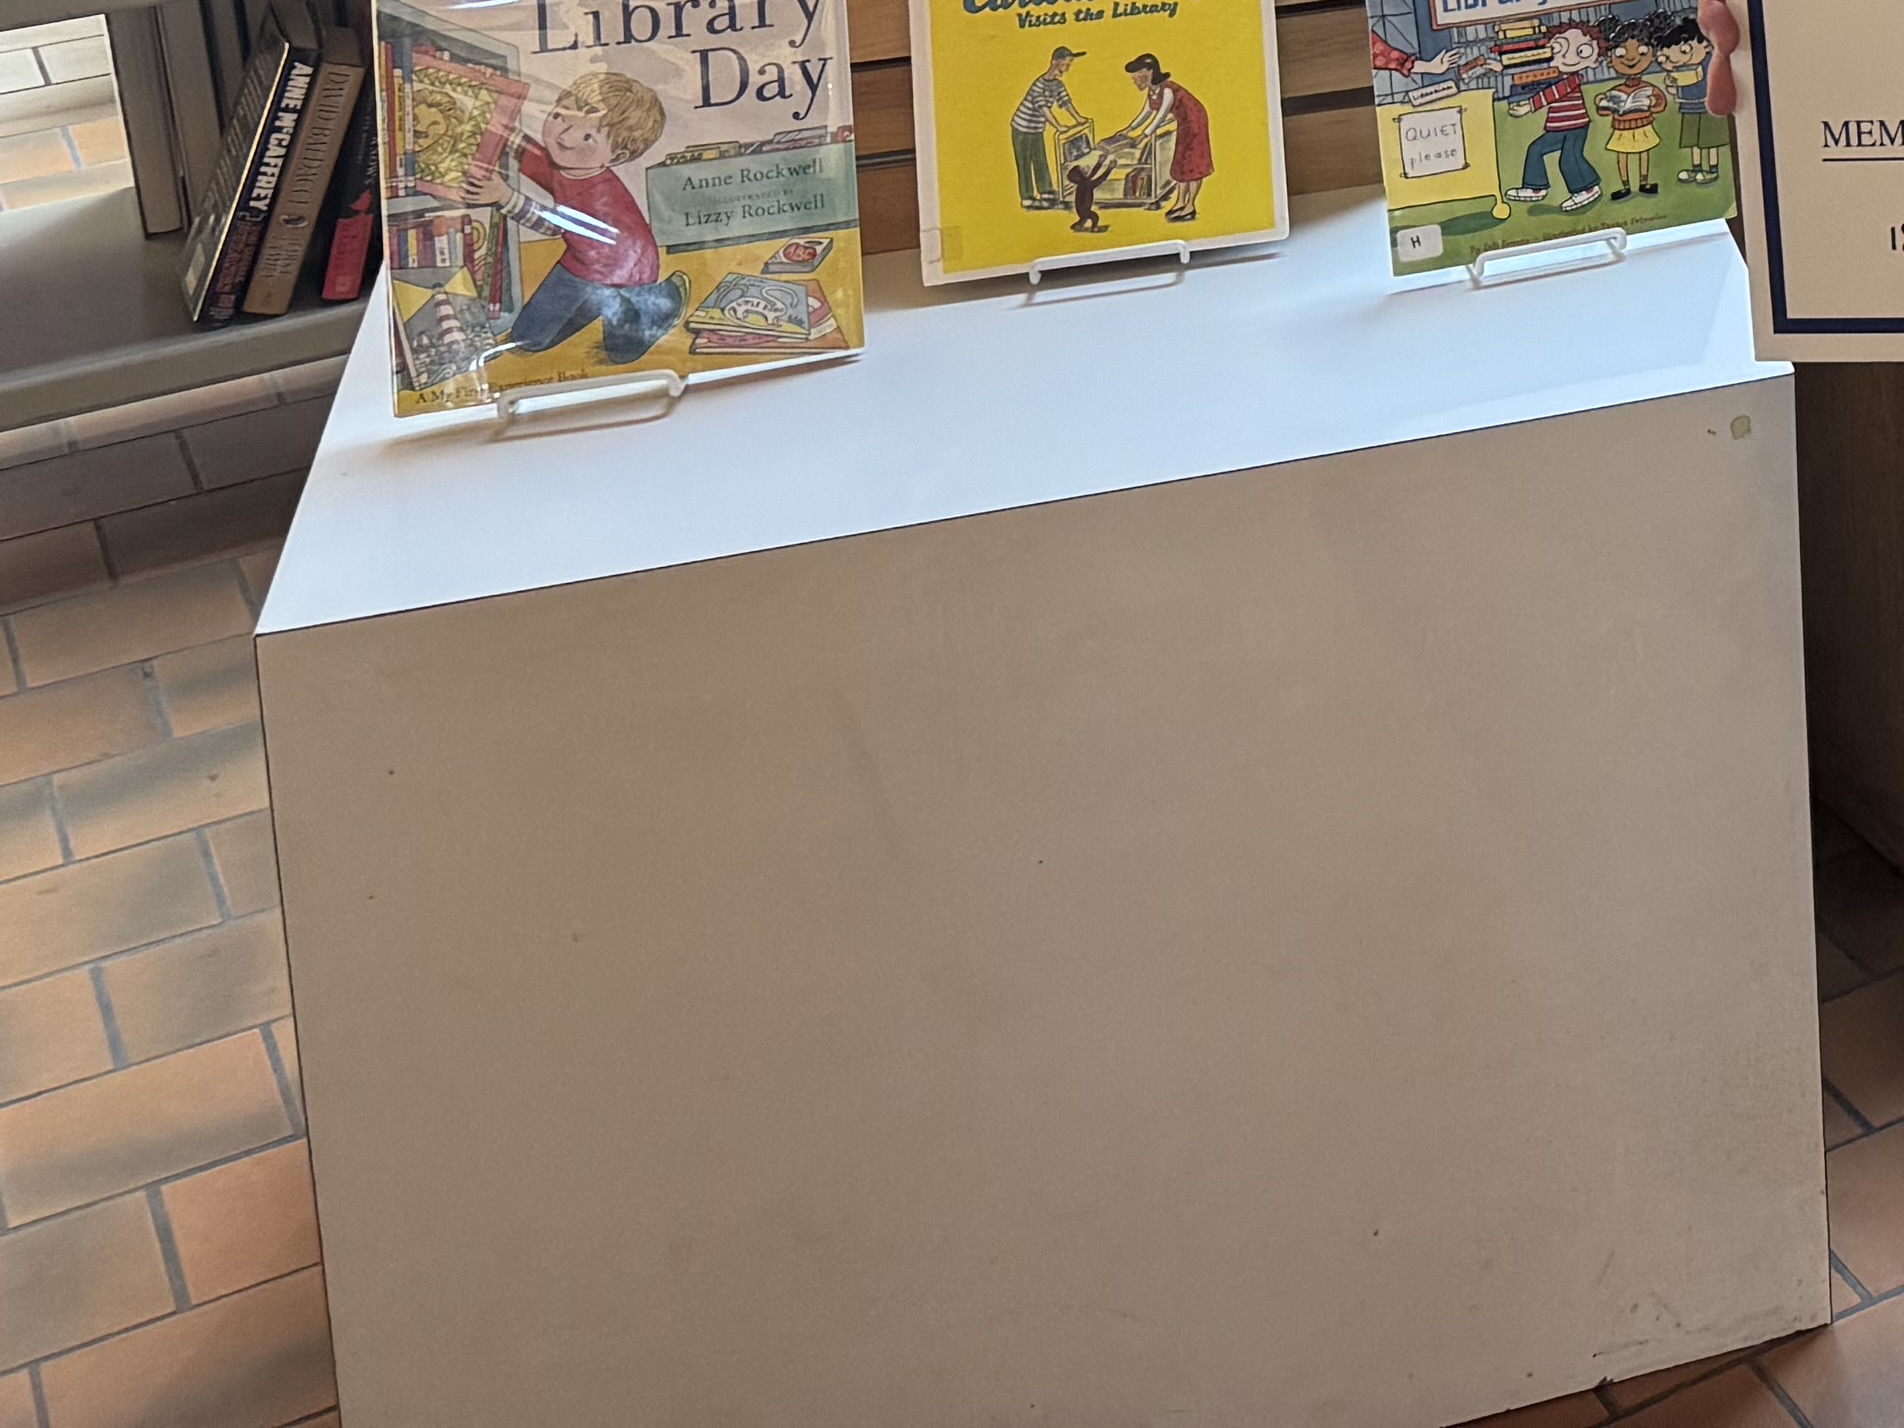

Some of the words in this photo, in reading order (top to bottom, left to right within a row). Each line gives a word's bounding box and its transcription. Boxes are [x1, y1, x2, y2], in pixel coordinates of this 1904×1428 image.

[1016, 7, 1068, 30] Visits
[1073, 6, 1105, 23] the
[1111, 0, 1179, 21] Library
[279, 61, 314, 111] ANNE
[317, 70, 351, 122] DAVID
[693, 46, 835, 122] Day
[1405, 121, 1459, 142] QUIET
[249, 110, 299, 212] McCAFFREY
[287, 125, 334, 205] BALDACCI
[681, 174, 733, 192] Anne
[740, 157, 824, 184] Rockwell
[1409, 147, 1458, 173] please
[684, 210, 735, 227] Lizzy
[741, 193, 826, 220] Rockwell
[1409, 235, 1422, 250] H
